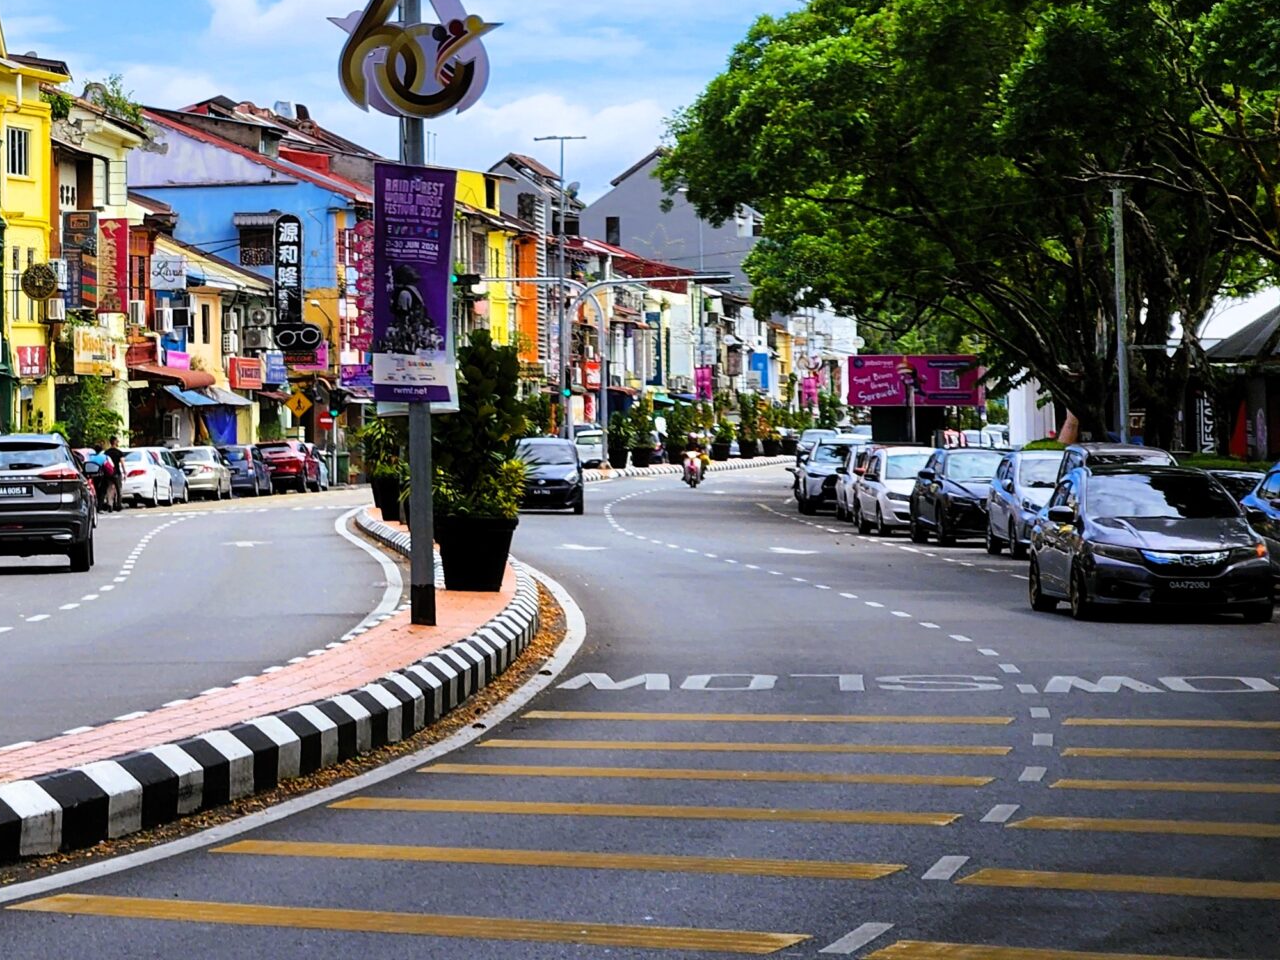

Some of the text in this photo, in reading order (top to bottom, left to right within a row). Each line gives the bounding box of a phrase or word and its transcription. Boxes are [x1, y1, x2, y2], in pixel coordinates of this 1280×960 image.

[384, 192, 443, 208] WORLD MUSIC
[384, 203, 419, 216] FESTIVAL
[278, 222, 300, 287] 源和隆
